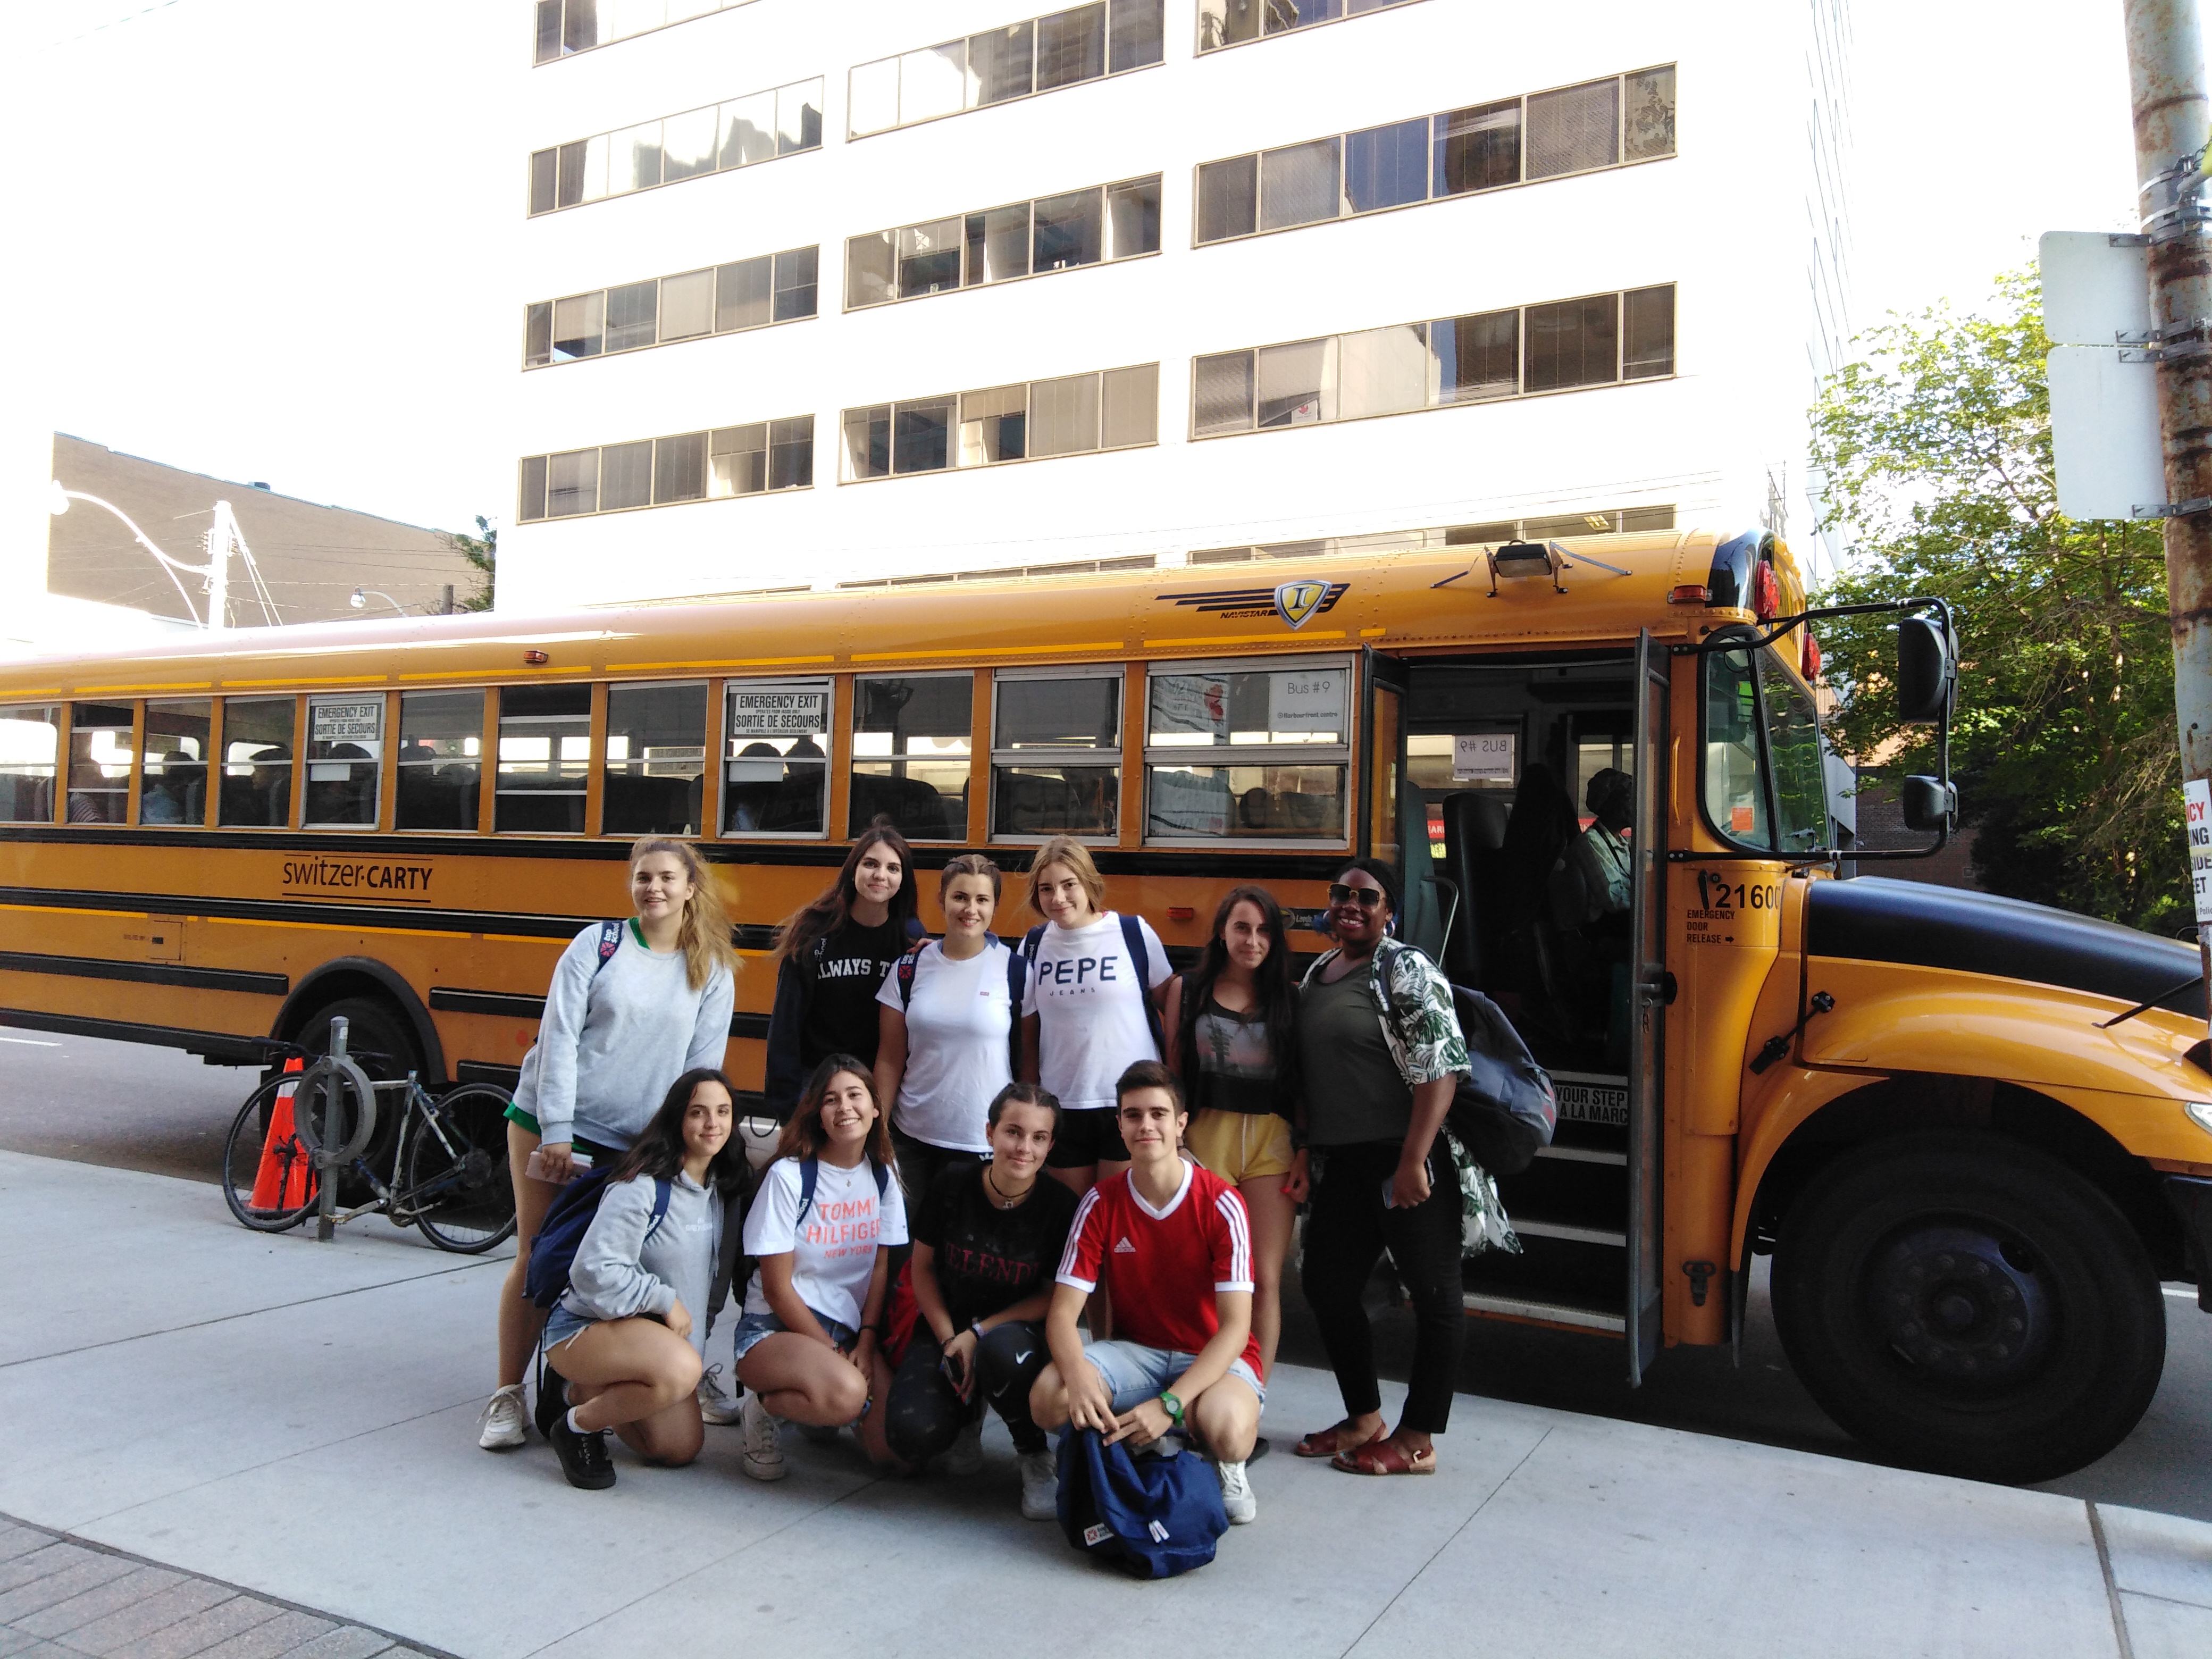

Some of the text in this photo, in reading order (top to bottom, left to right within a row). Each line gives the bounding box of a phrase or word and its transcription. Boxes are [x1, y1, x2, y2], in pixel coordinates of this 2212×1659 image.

[1220, 610, 1268, 619] NAVISTAR
[1287, 682, 1309, 694] Bus
[740, 696, 818, 708] EMERGENCY EXIT
[318, 706, 375, 718] EMERGENCY EXIT
[736, 715, 820, 728] SORTIE DE SECOURS
[315, 722, 375, 735] SORTIE DE SECOURS
[1687, 909, 1735, 920] EMERGENCY
[1687, 921, 1708, 931] DOOR
[1687, 933, 1721, 944] RELEASE
[1038, 956, 1118, 985] PEPE
[1049, 987, 1096, 997] JEANS
[1555, 1086, 1625, 1107] YOUR STEP
[1571, 1103, 1586, 1120] LA
[824, 1244, 873, 1258] NEW YORK
